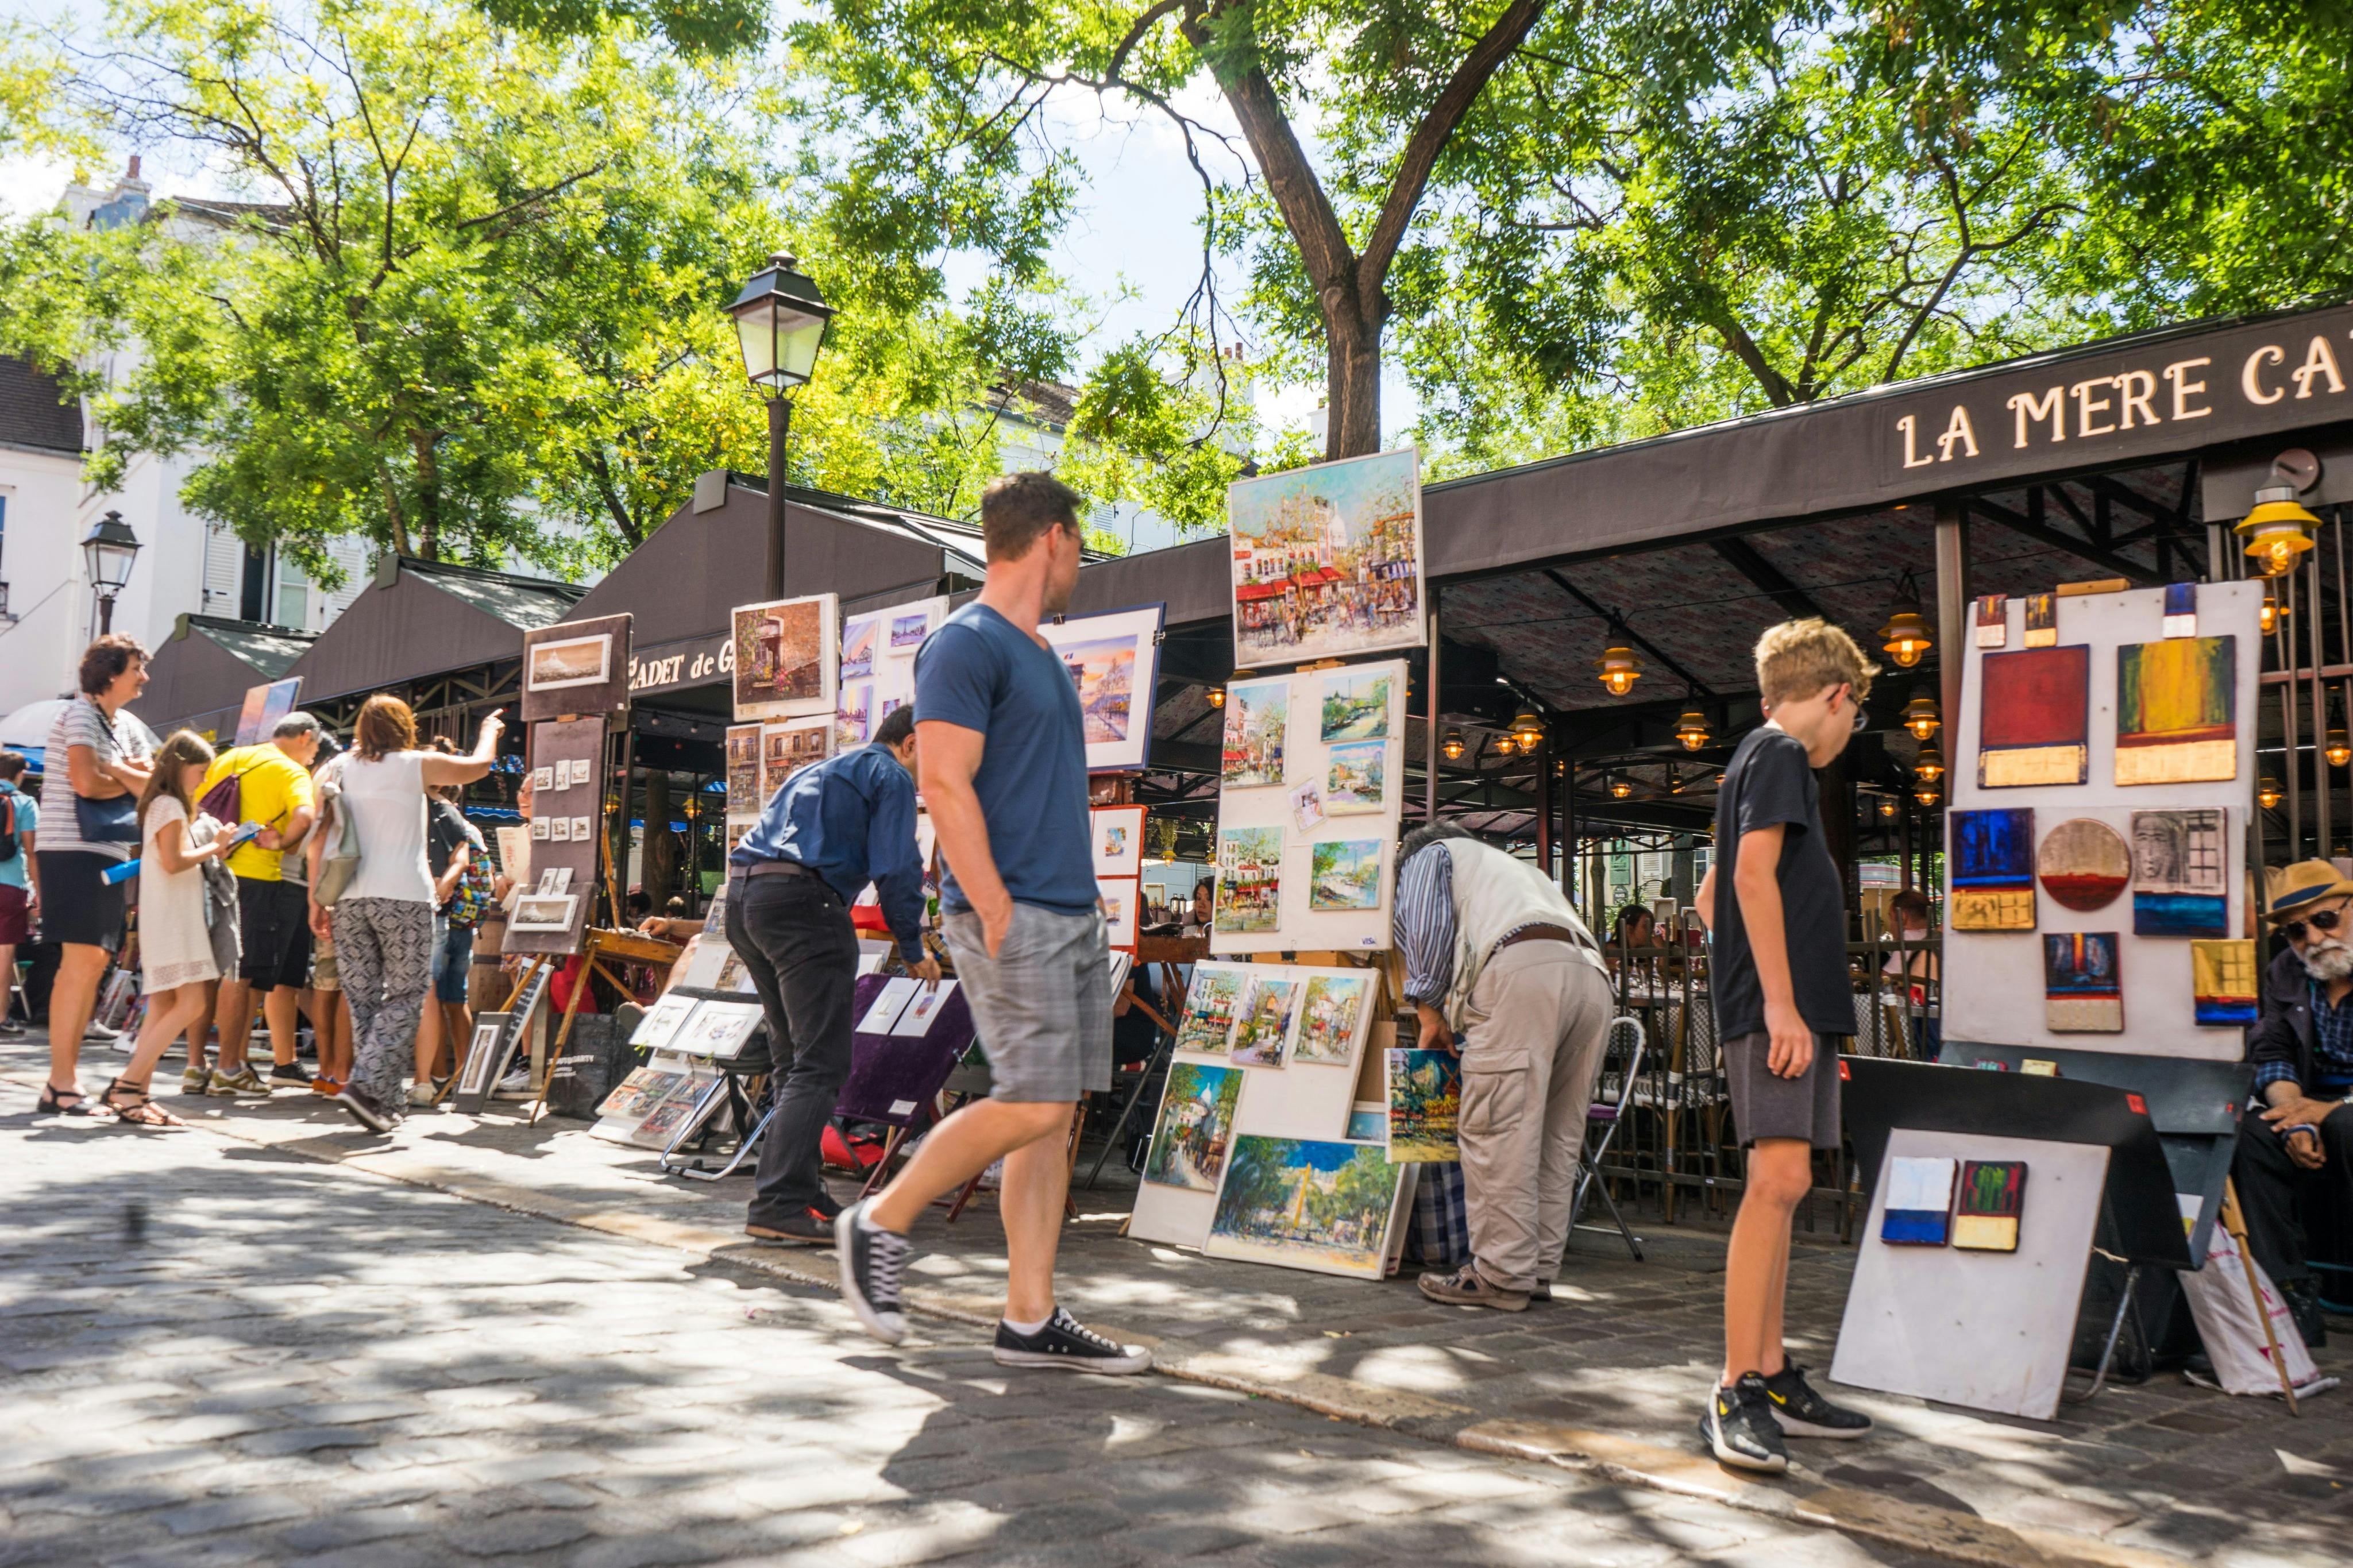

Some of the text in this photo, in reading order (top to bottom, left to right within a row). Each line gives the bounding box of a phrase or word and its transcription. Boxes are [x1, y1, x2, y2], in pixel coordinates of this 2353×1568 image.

[1896, 329, 2353, 468] LA MERE CA
[690, 652, 715, 679] de
